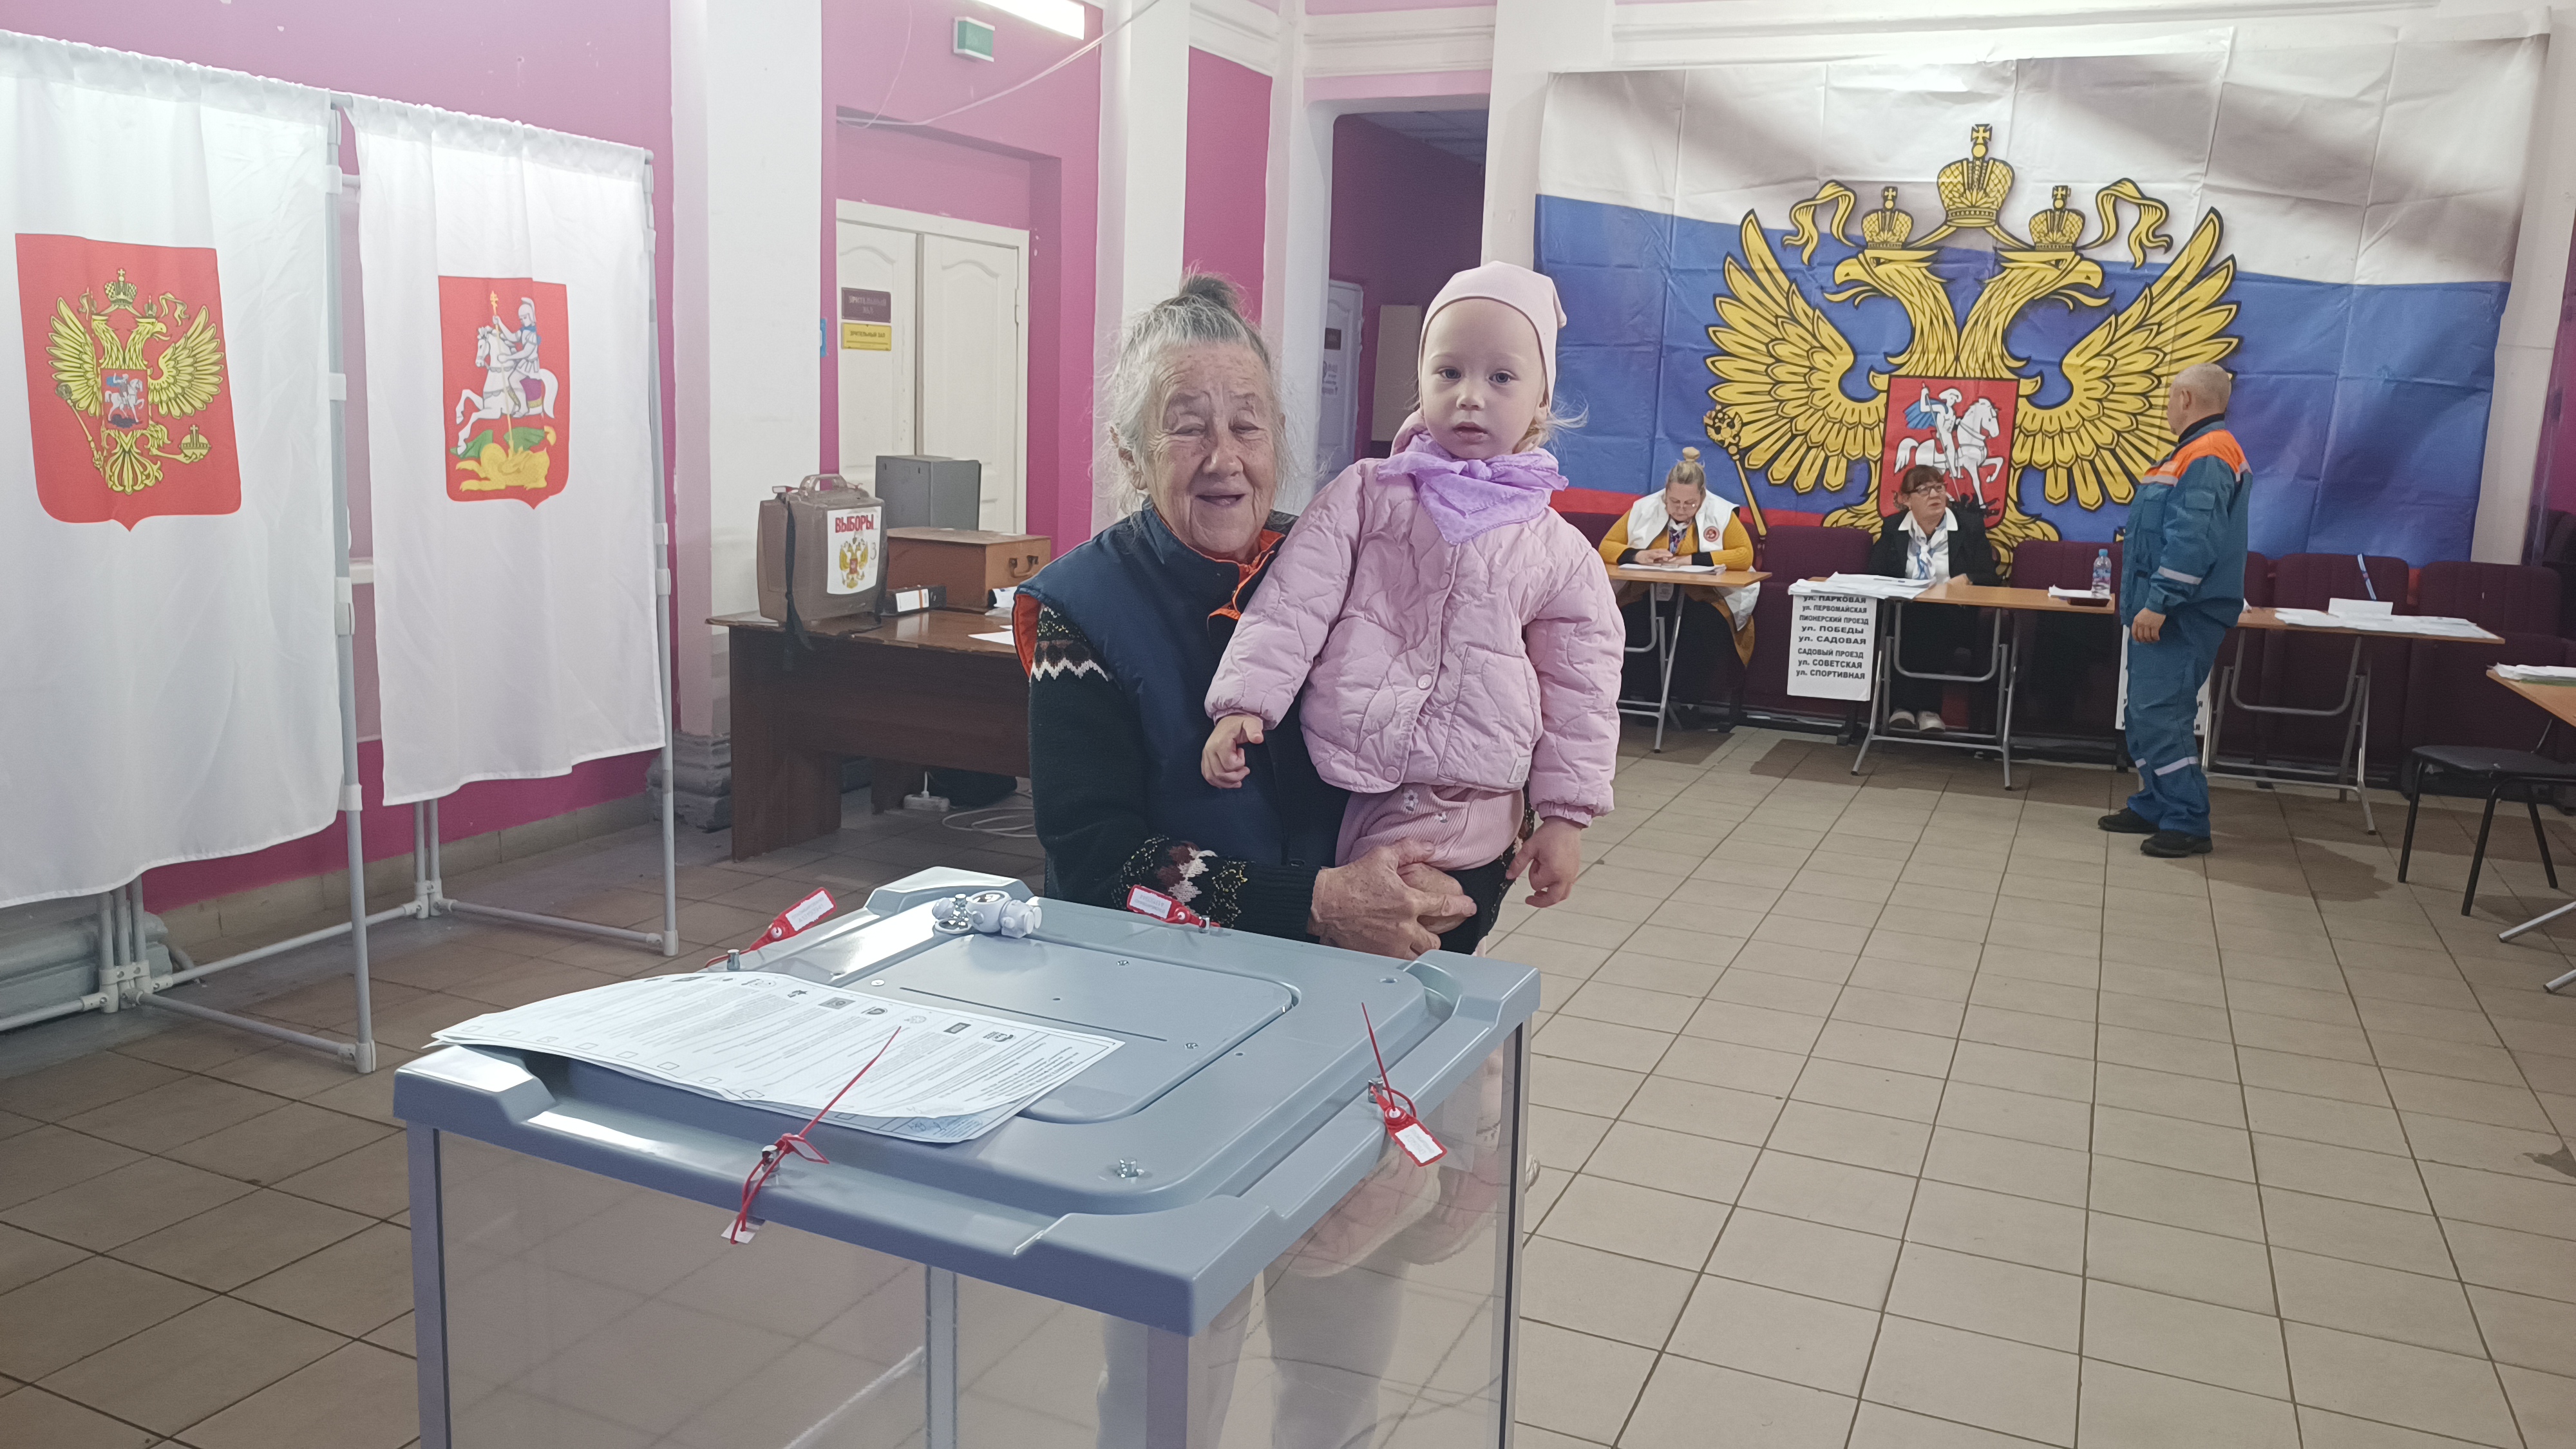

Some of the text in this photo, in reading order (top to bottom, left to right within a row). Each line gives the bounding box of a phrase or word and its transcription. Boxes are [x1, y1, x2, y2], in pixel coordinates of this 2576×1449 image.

[835, 514, 874, 533] ВЫБОРЫ
[1814, 605, 1867, 613] ПЕРВОМАЙСКАЯ
[1844, 617, 1869, 625] ПРОЕЗД
[1819, 626, 1864, 634] ПОБЕДЫ
[1816, 636, 1866, 645] САДОВАЯ
[1835, 650, 1864, 659] ПРОЕЗД
[1812, 659, 1862, 668] СОВЕТСКАЯ
[1810, 669, 1865, 679] СПОРТИВНАЯ
